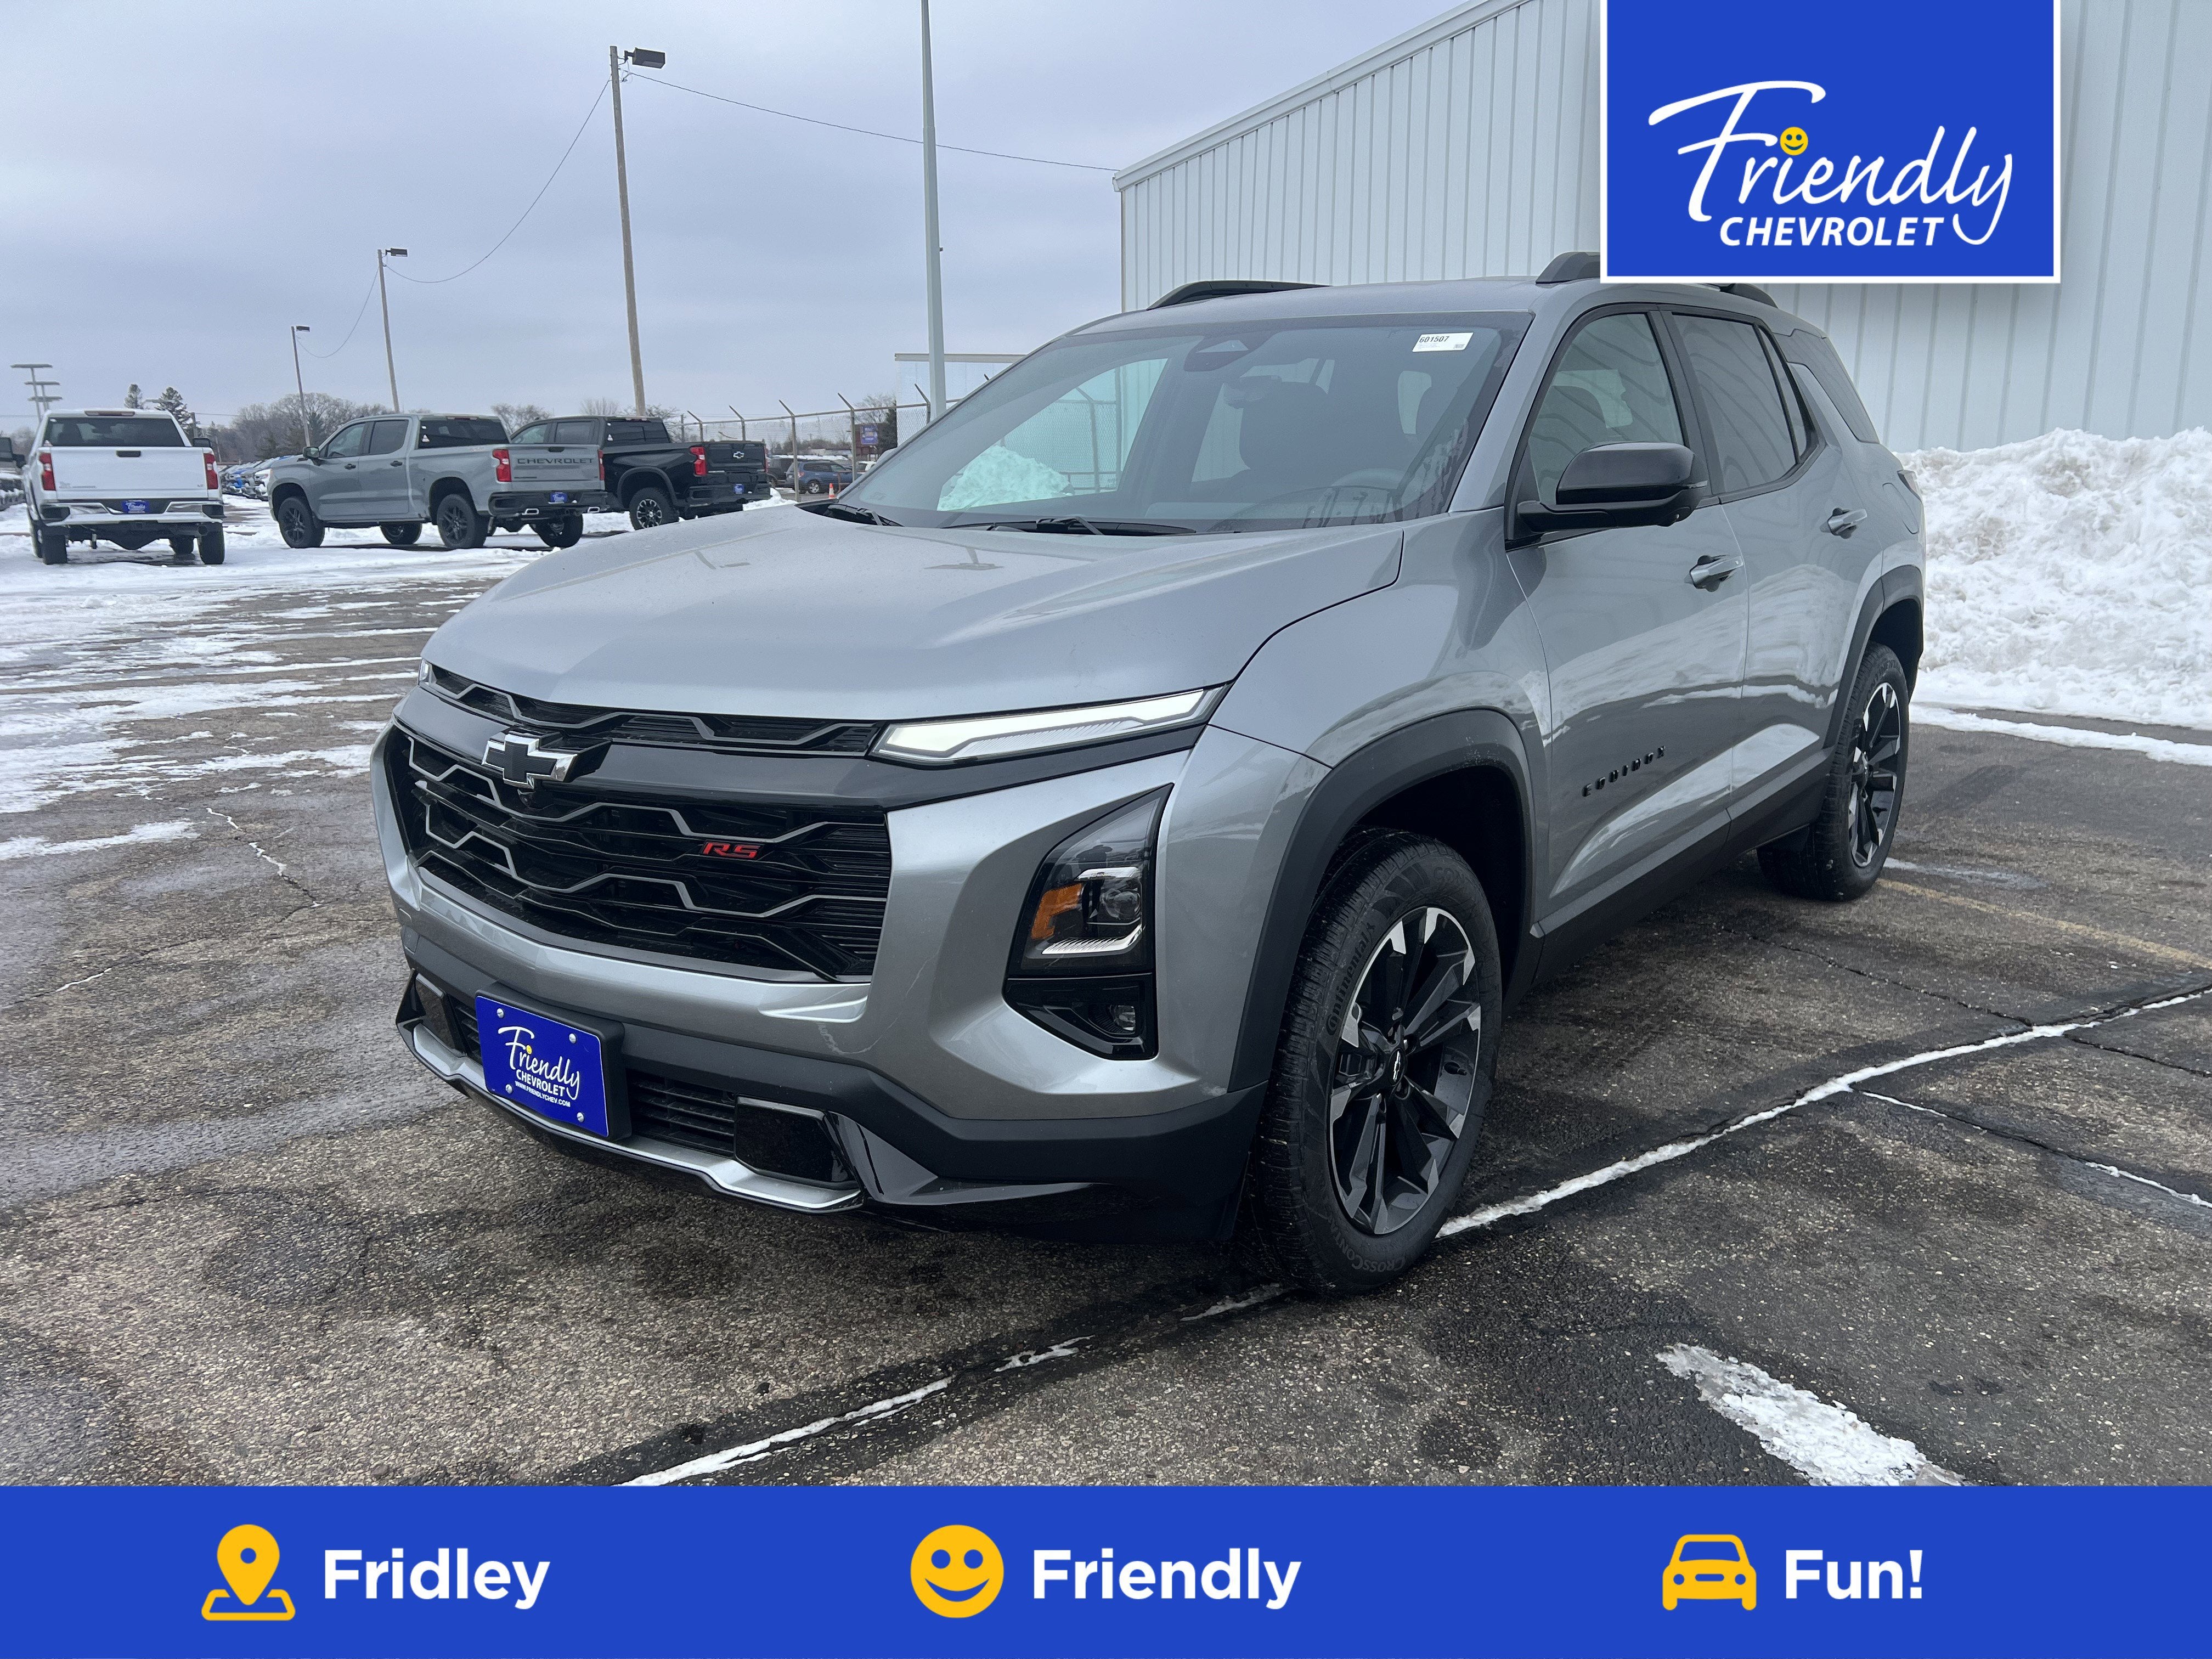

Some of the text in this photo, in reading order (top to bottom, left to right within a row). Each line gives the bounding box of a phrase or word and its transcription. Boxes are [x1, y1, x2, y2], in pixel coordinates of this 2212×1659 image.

[703, 842, 761, 859] RS
[498, 1026, 581, 1101] Friendly
[515, 1081, 571, 1108] WWW.FRIENDLYCHEV.COM
[516, 1069, 566, 1097] CHEVROLET
